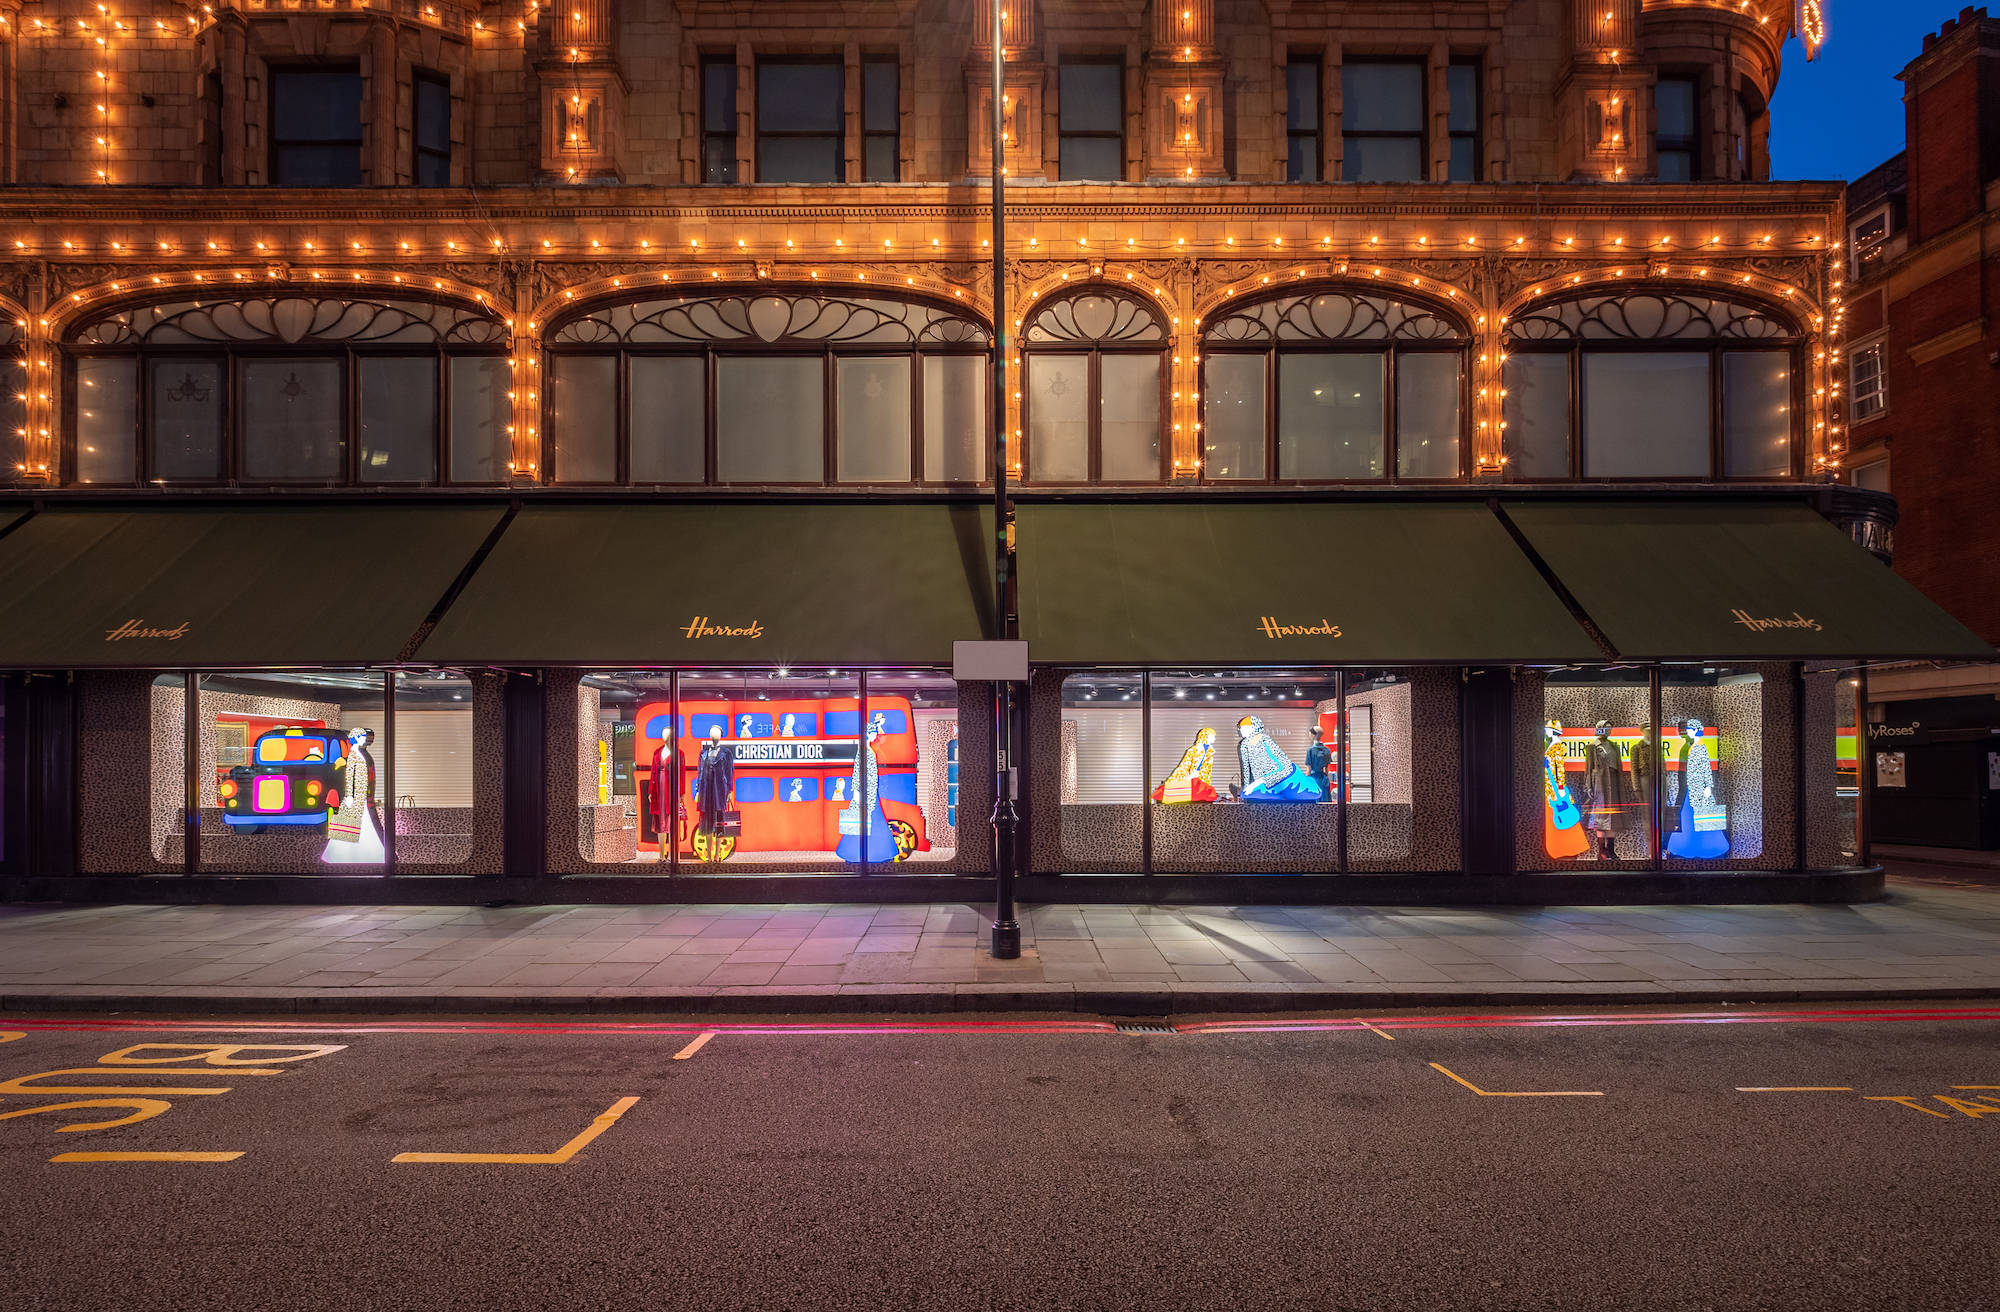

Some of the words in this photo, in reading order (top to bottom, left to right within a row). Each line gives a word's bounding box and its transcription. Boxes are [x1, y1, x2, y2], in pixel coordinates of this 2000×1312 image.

[105, 619, 191, 641] Harrods
[680, 616, 764, 639] Harrods
[1256, 616, 1342, 639] Harrods
[1730, 608, 1822, 632] Harrods
[735, 744, 792, 759] CHRISTIAN
[797, 744, 823, 759] DIOR
[1863, 1094, 2000, 1119] TA
